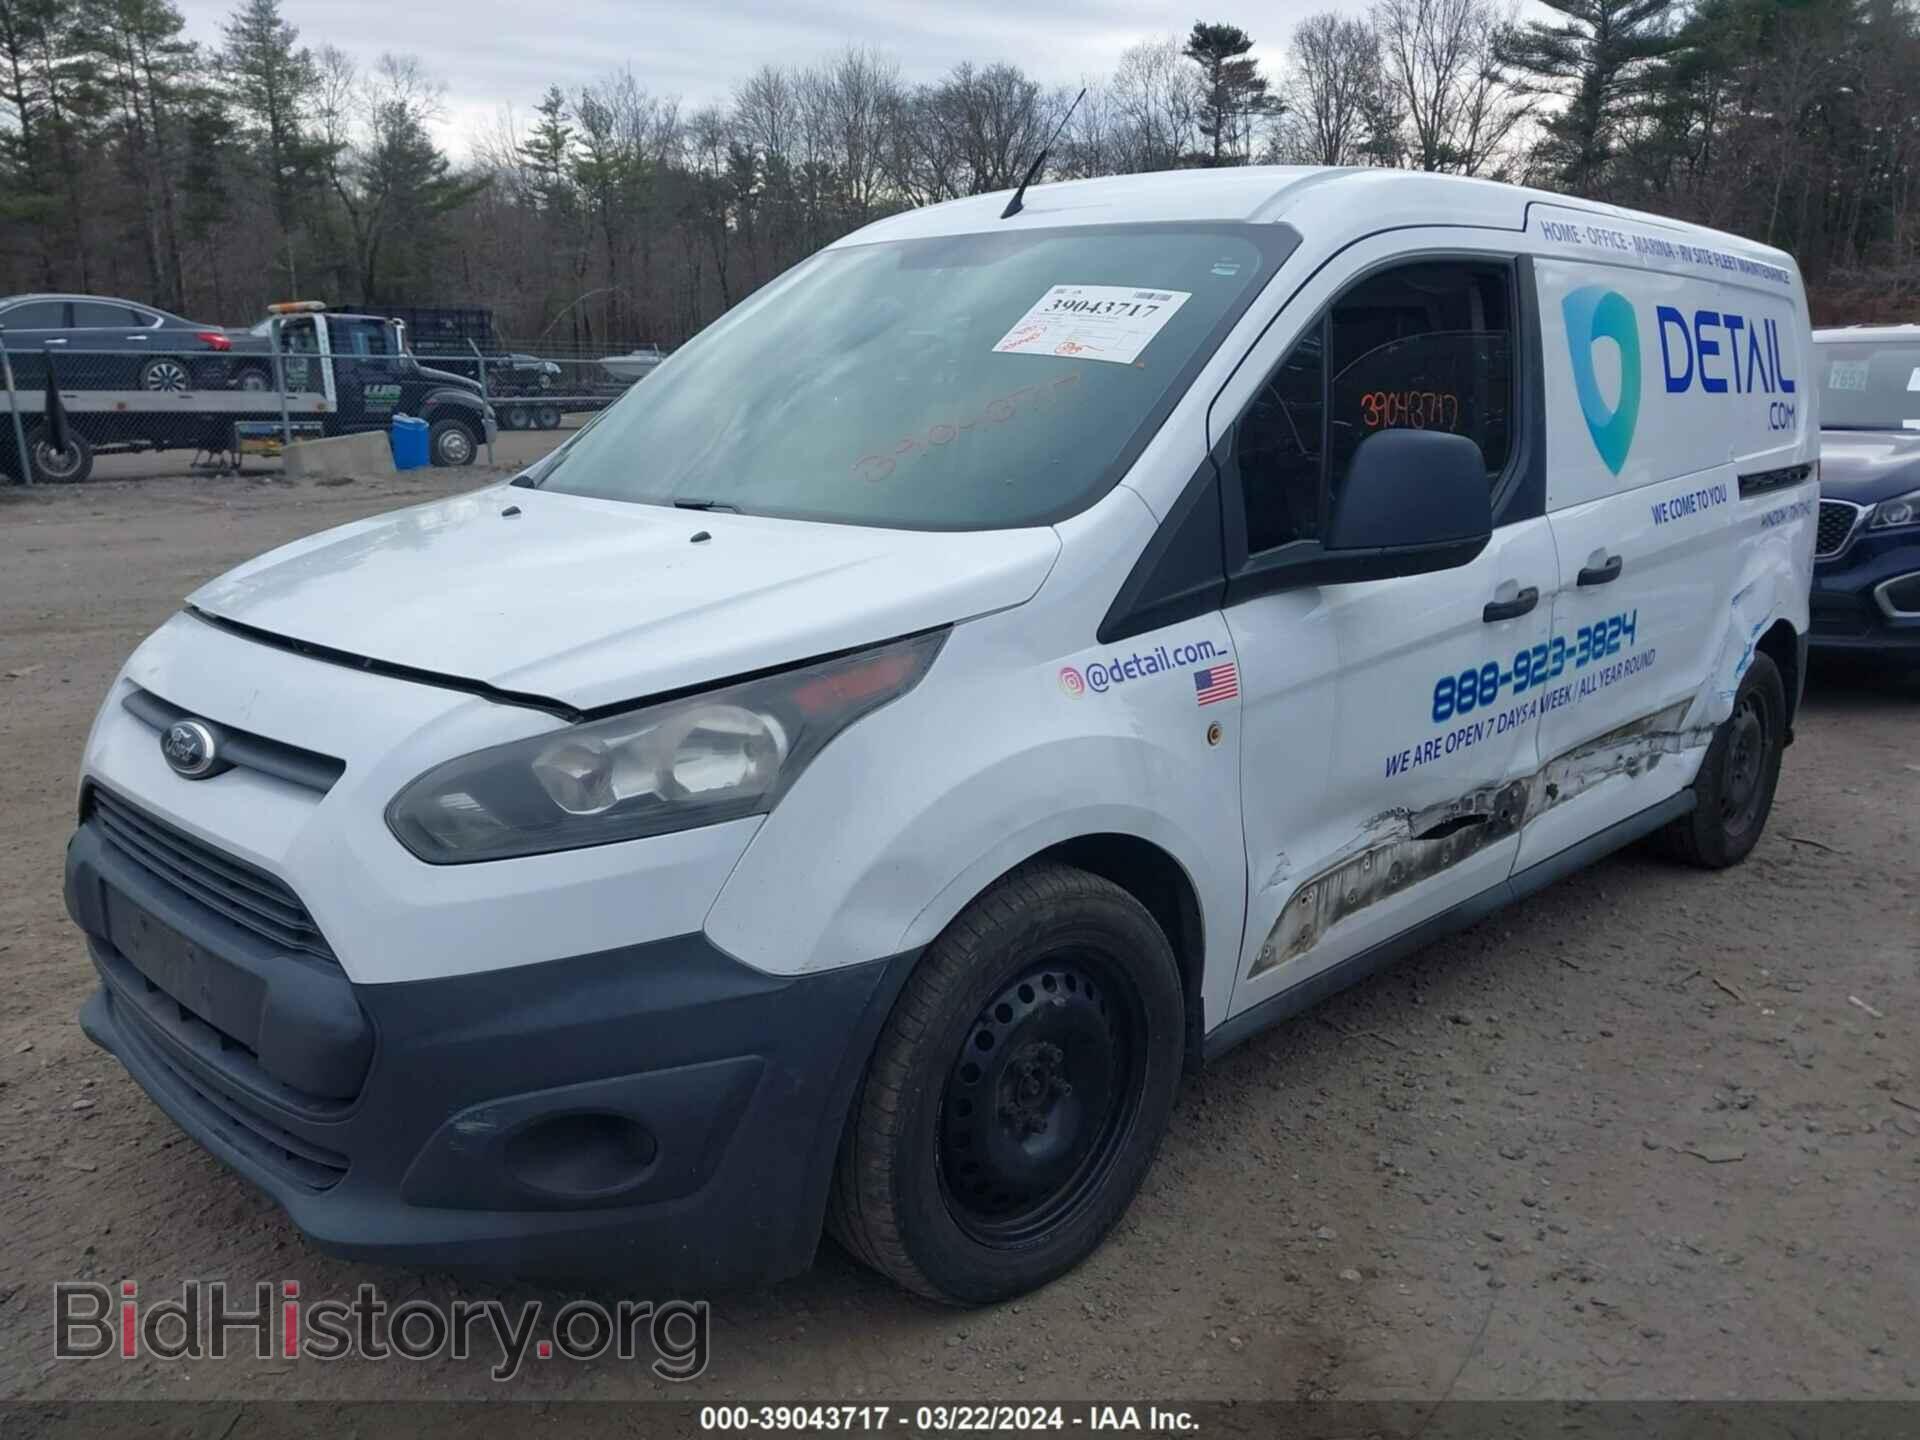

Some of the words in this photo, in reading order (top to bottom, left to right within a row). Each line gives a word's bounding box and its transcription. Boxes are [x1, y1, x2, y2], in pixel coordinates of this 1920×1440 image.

[1540, 221, 1582, 243] HOME
[1586, 226, 1628, 250] OFFICE
[1045, 298, 1160, 319] 39043717
[1656, 305, 1796, 394] DETAIL
[1768, 402, 1796, 430] .COM
[1651, 503, 1669, 525] WE
[1669, 492, 1697, 520] COME
[1697, 488, 1708, 509] TO
[1708, 483, 1728, 506] YOU
[1432, 608, 1637, 724] 888-923-3824
[1385, 748, 1411, 778] WE
[1413, 737, 1443, 768] ARE
[1445, 722, 1484, 754] OPEN
[1486, 719, 1495, 739] 7
[1497, 704, 1529, 734] DAYS
[1528, 700, 1538, 720] A
[1539, 682, 1573, 715] WEEK
[1578, 675, 1599, 701] ALL
[1600, 662, 1625, 689] YEAR
[1623, 648, 1656, 677] ROUND
